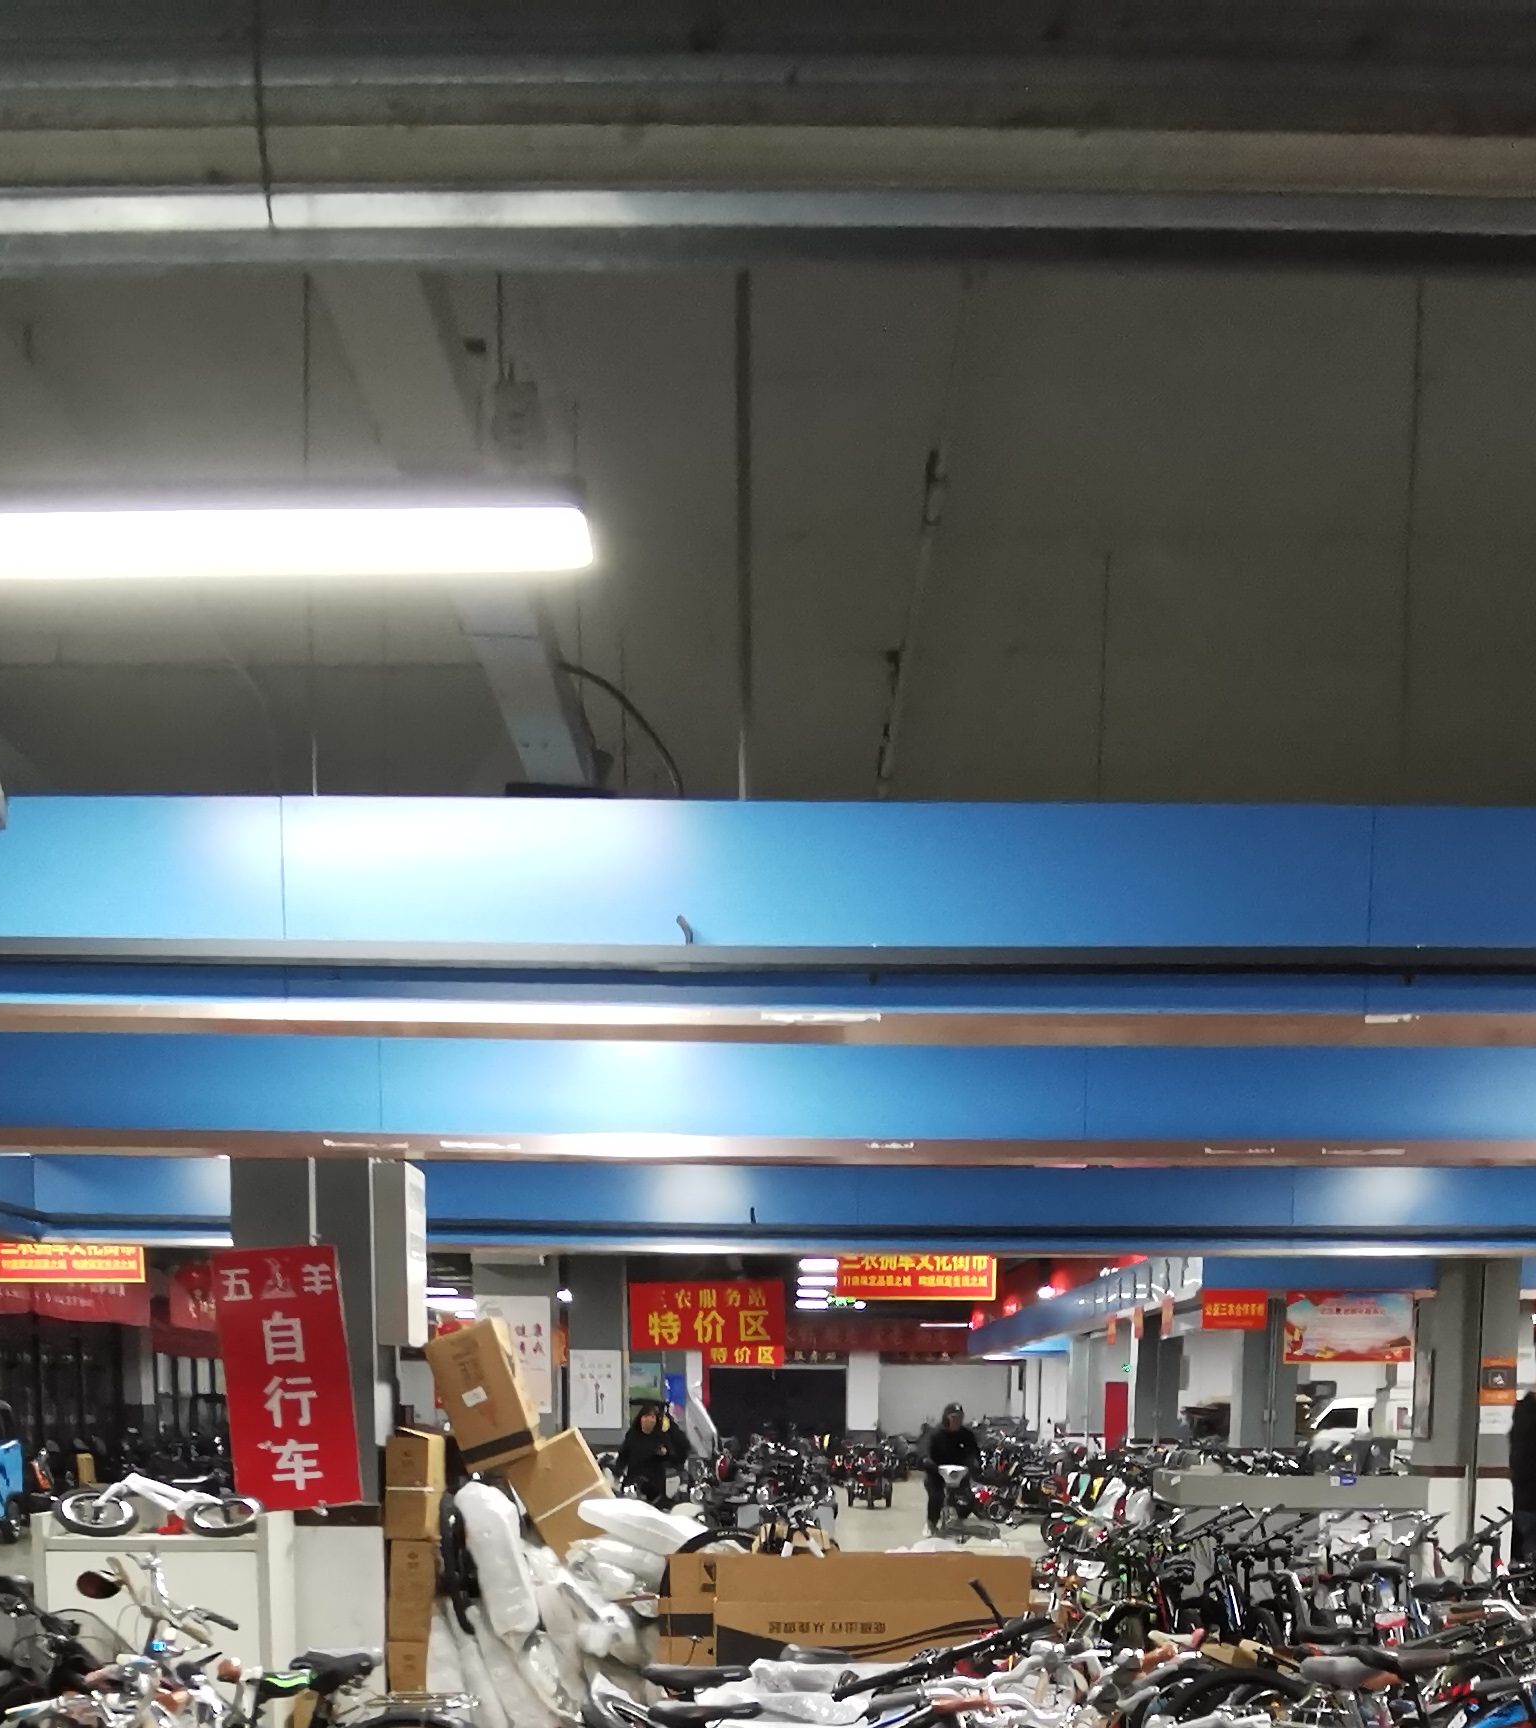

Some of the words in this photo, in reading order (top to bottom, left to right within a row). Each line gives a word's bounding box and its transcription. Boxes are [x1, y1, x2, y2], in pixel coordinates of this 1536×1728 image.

[648, 1310, 771, 1345] 特价区
[261, 1311, 324, 1491] 自行车
